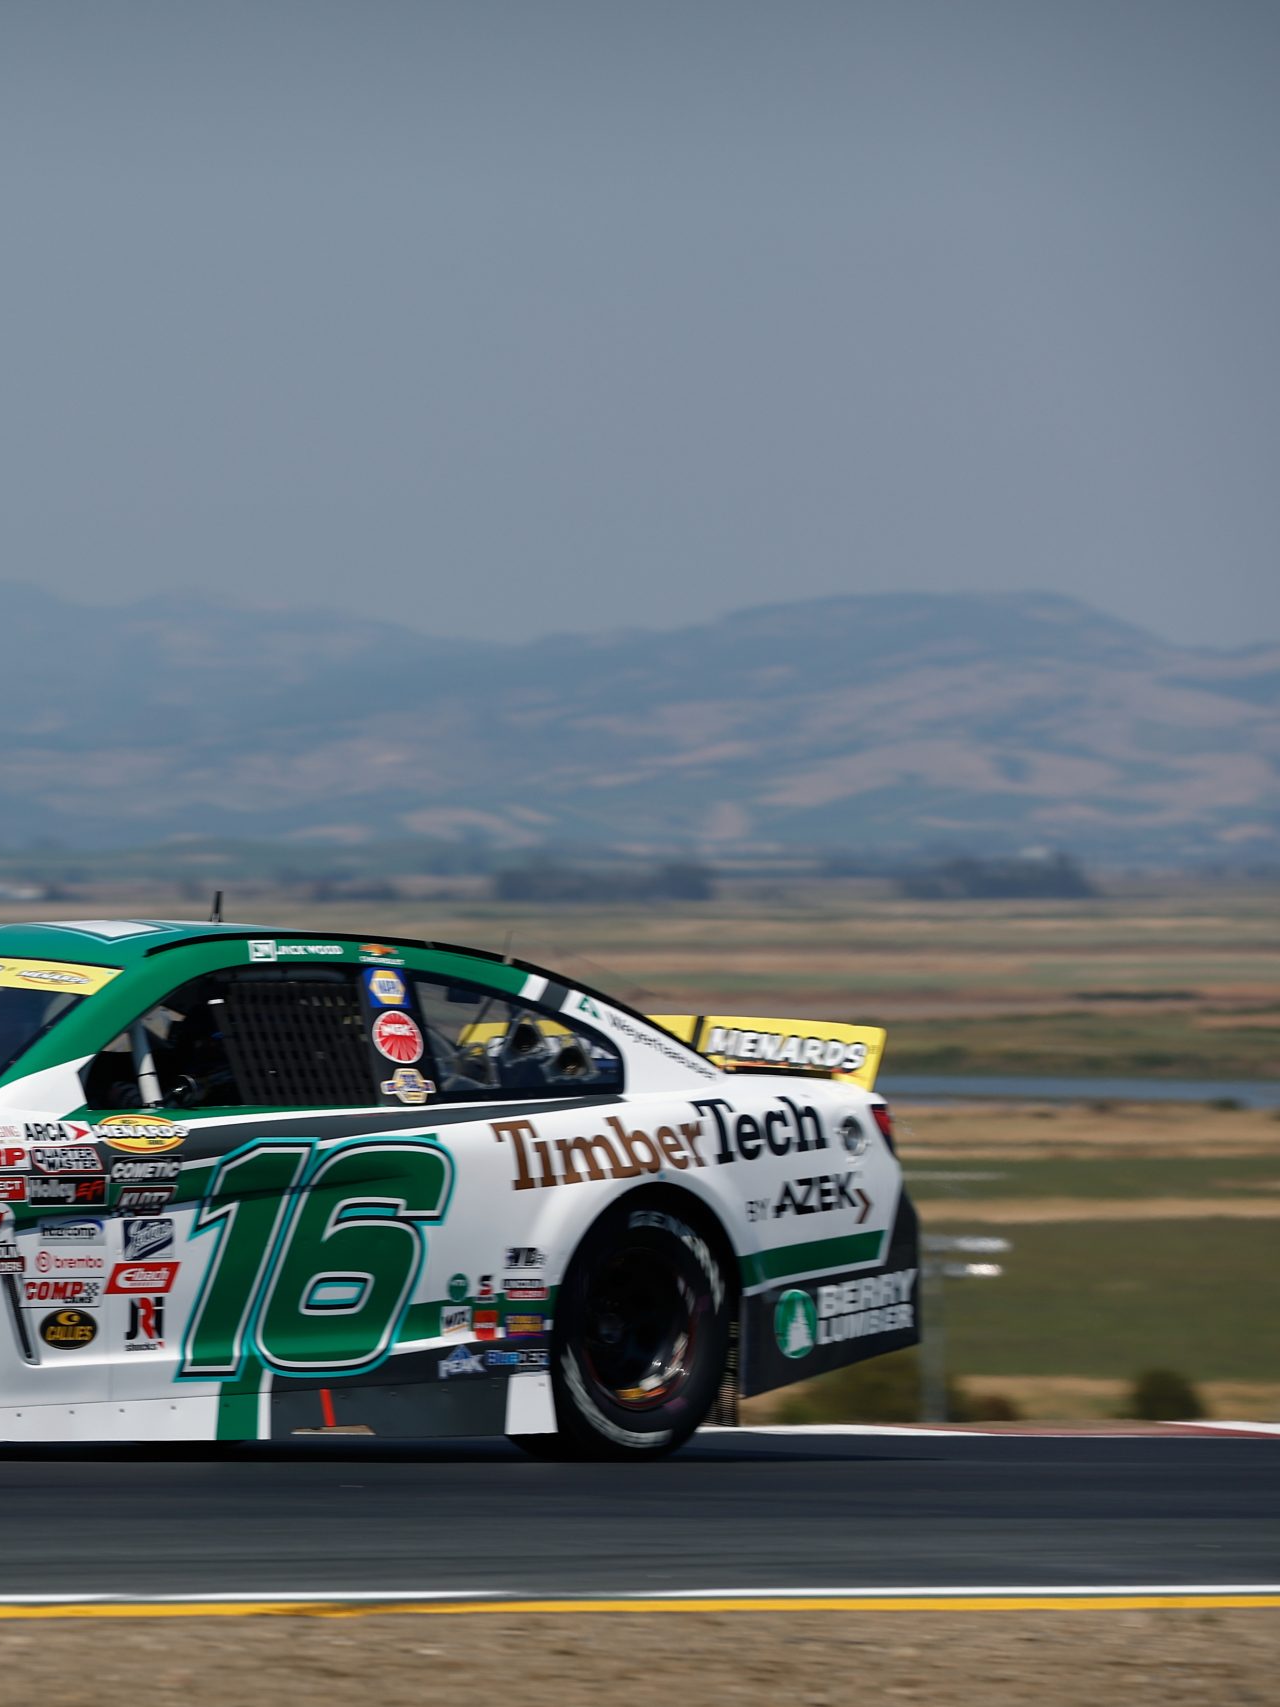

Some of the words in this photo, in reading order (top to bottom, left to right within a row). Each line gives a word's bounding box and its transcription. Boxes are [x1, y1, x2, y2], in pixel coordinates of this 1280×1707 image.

[306, 945, 344, 955] WOOD
[19, 970, 92, 985] MENARDS
[706, 1026, 868, 1071] MENARDS
[24, 1122, 70, 1141] ARCA
[90, 1124, 189, 1139] MENARDS
[489, 1096, 830, 1190] TimberTech
[111, 1161, 180, 1179] COMETIC
[747, 1197, 772, 1222] BY
[772, 1170, 860, 1218] AZEK
[54, 1256, 104, 1269] brembo
[172, 1135, 456, 1382] 16
[116, 1268, 170, 1289] Eibach
[24, 1281, 84, 1301] COMP
[817, 1268, 918, 1319] BERRY
[46, 1325, 93, 1341] CALLIES
[816, 1304, 914, 1345] LUMBER
[438, 1354, 488, 1379] PEAK
